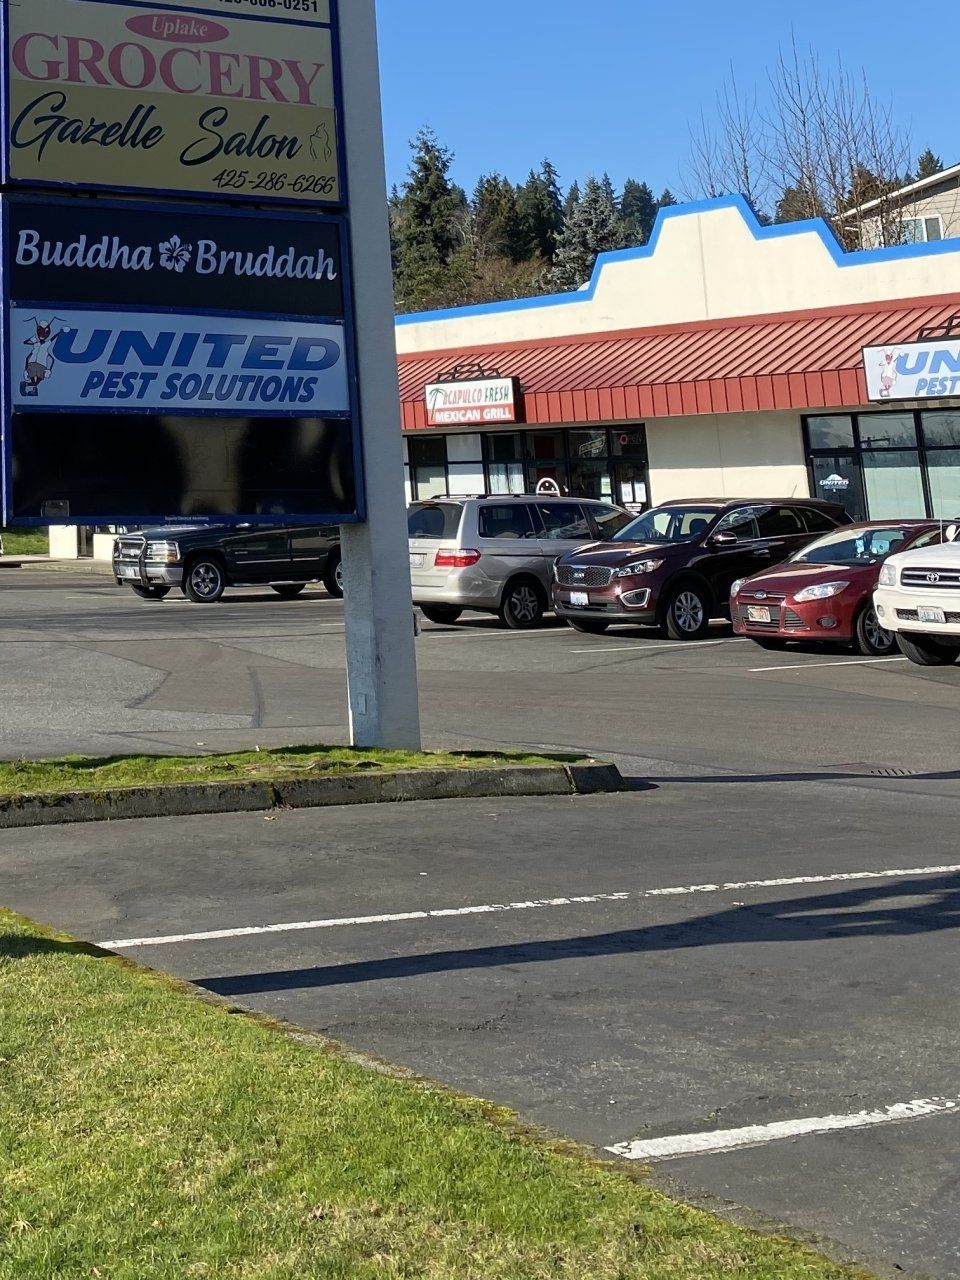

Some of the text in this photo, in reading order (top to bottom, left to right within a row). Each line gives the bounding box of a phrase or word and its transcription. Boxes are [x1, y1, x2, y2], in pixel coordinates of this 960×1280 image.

[151, 15, 209, 38] Uplake
[11, 32, 326, 106] GROCERY
[10, 90, 303, 167] Gazelle Salon
[212, 169, 336, 195] 425-286-6266
[15, 229, 337, 281] Buddha Bruddah
[52, 328, 341, 371] UNITED
[80, 370, 318, 403] PEST SOLUTIONS
[443, 384, 510, 406] ACAPULCO FRESH
[914, 375, 960, 396] PEST
[435, 406, 512, 423] MEXICAN GRILL
